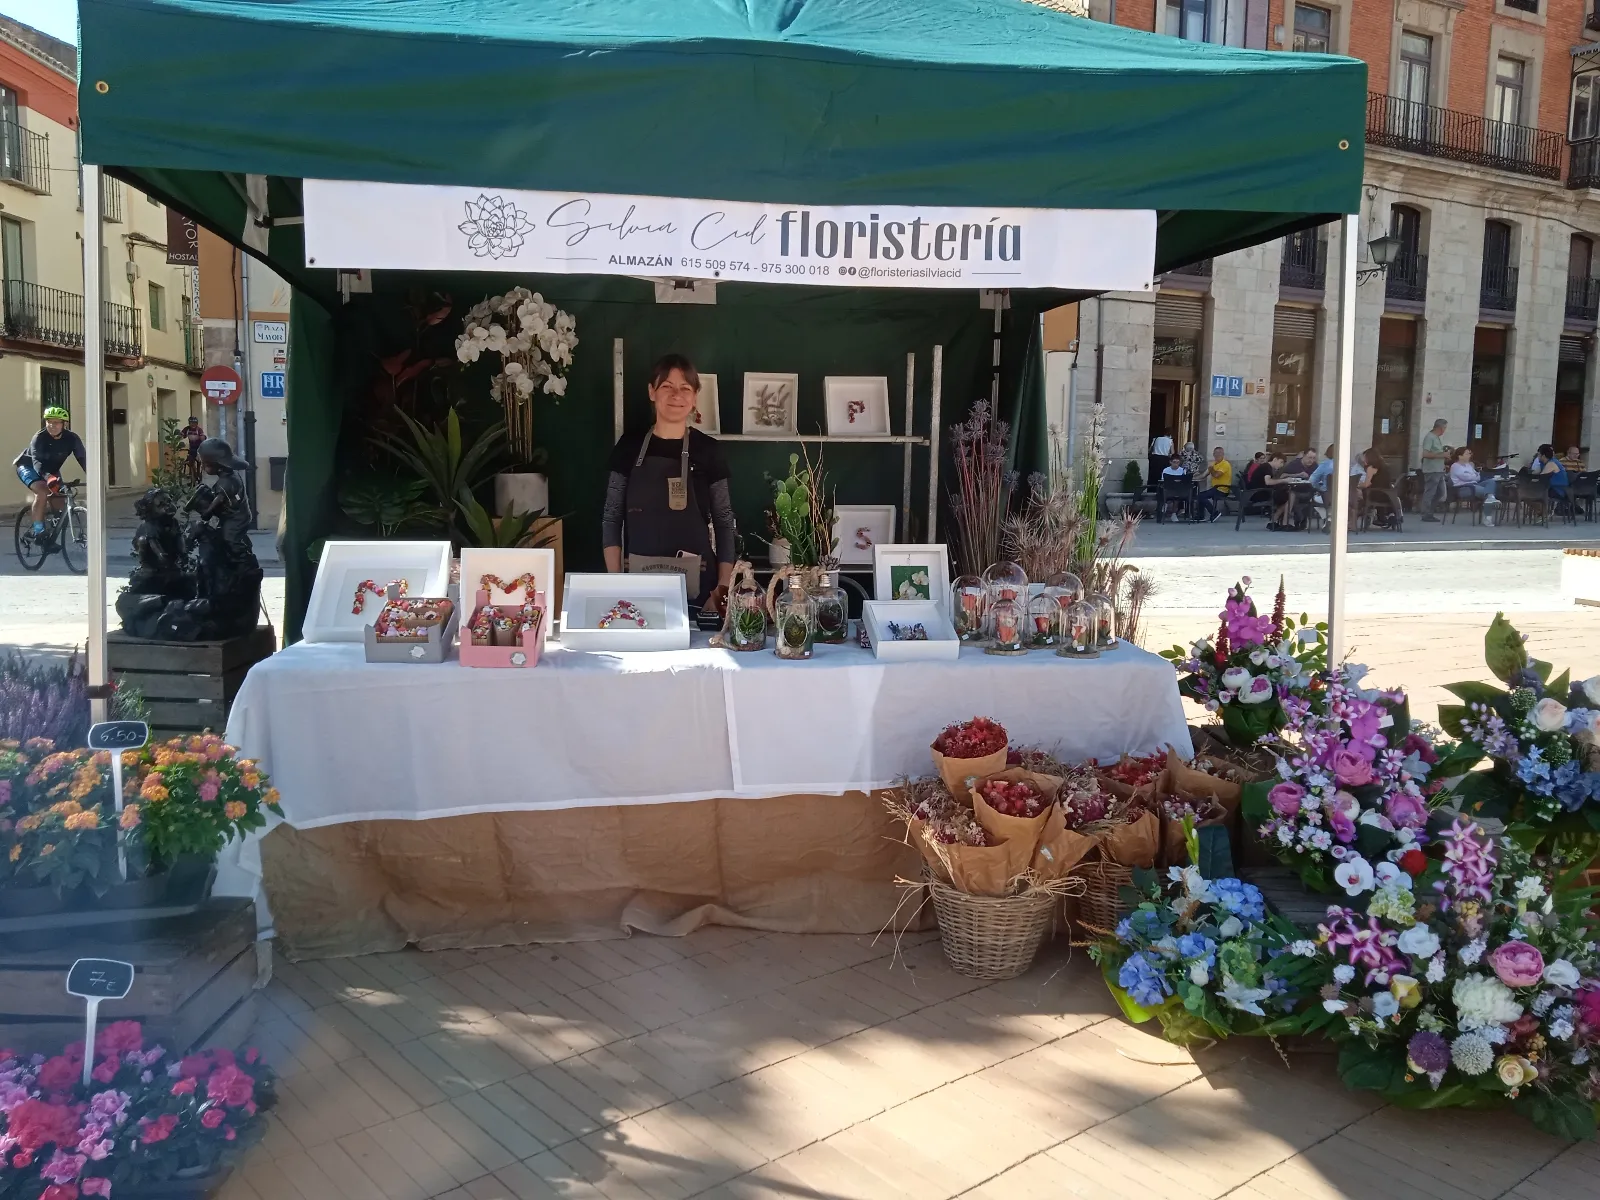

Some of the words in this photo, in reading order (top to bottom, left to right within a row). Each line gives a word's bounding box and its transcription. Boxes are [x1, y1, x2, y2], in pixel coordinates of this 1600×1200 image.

[181, 216, 199, 249] YOR
[691, 211, 768, 251] Cid
[776, 211, 1022, 262] floristería
[168, 252, 199, 261] HOSTAL
[608, 254, 673, 267] ALMAZÁN
[681, 257, 702, 269] 615
[705, 259, 726, 271] 509
[729, 260, 750, 272] 574
[761, 262, 782, 274] 975
[785, 264, 806, 275] 300
[809, 265, 830, 276] 018
[858, 266, 962, 279] @floristeriasilviacid
[257, 332, 283, 341] MAYOR
[263, 324, 284, 332] PLAZA
[1215, 377, 1225, 389] H
[1231, 378, 1240, 390] R
[847, 400, 866, 424] P
[854, 526, 873, 551] S
